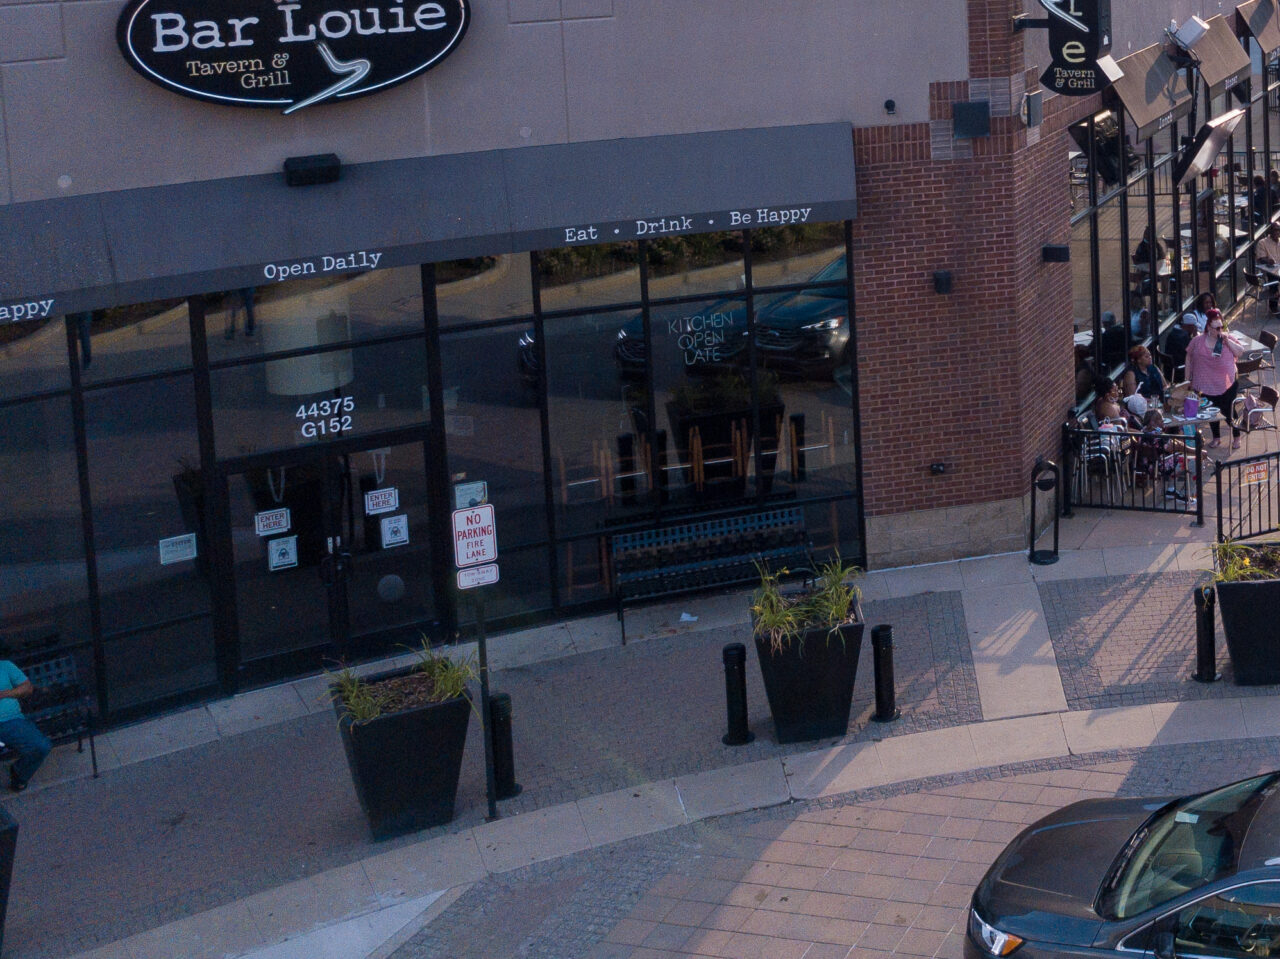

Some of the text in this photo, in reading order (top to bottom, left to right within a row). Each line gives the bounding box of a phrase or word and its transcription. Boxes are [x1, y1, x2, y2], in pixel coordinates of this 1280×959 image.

[151, 12, 260, 53] Bar
[186, 53, 290, 77] Tavern &
[1053, 67, 1096, 79] Tavern
[240, 70, 292, 90] Grill
[1055, 78, 1096, 89] & Grill
[564, 207, 812, 243] Eat Drink Be Happy
[263, 251, 383, 282] Open Daily
[0, 298, 55, 322] appy
[667, 311, 734, 335] KITCHEN
[677, 329, 724, 350] OPEN
[684, 346, 723, 366] LATE
[295, 396, 355, 420] 44375
[301, 415, 353, 438] G152
[1256, 464, 1266, 472] NOT
[369, 491, 394, 502] ENTER
[372, 498, 392, 508] HERE
[260, 511, 286, 523] ENTER
[262, 520, 283, 530] HERE
[466, 513, 482, 527] NO
[457, 524, 493, 542] PARKING
[466, 538, 485, 550] FIRE
[466, 548, 487, 560] LANE
